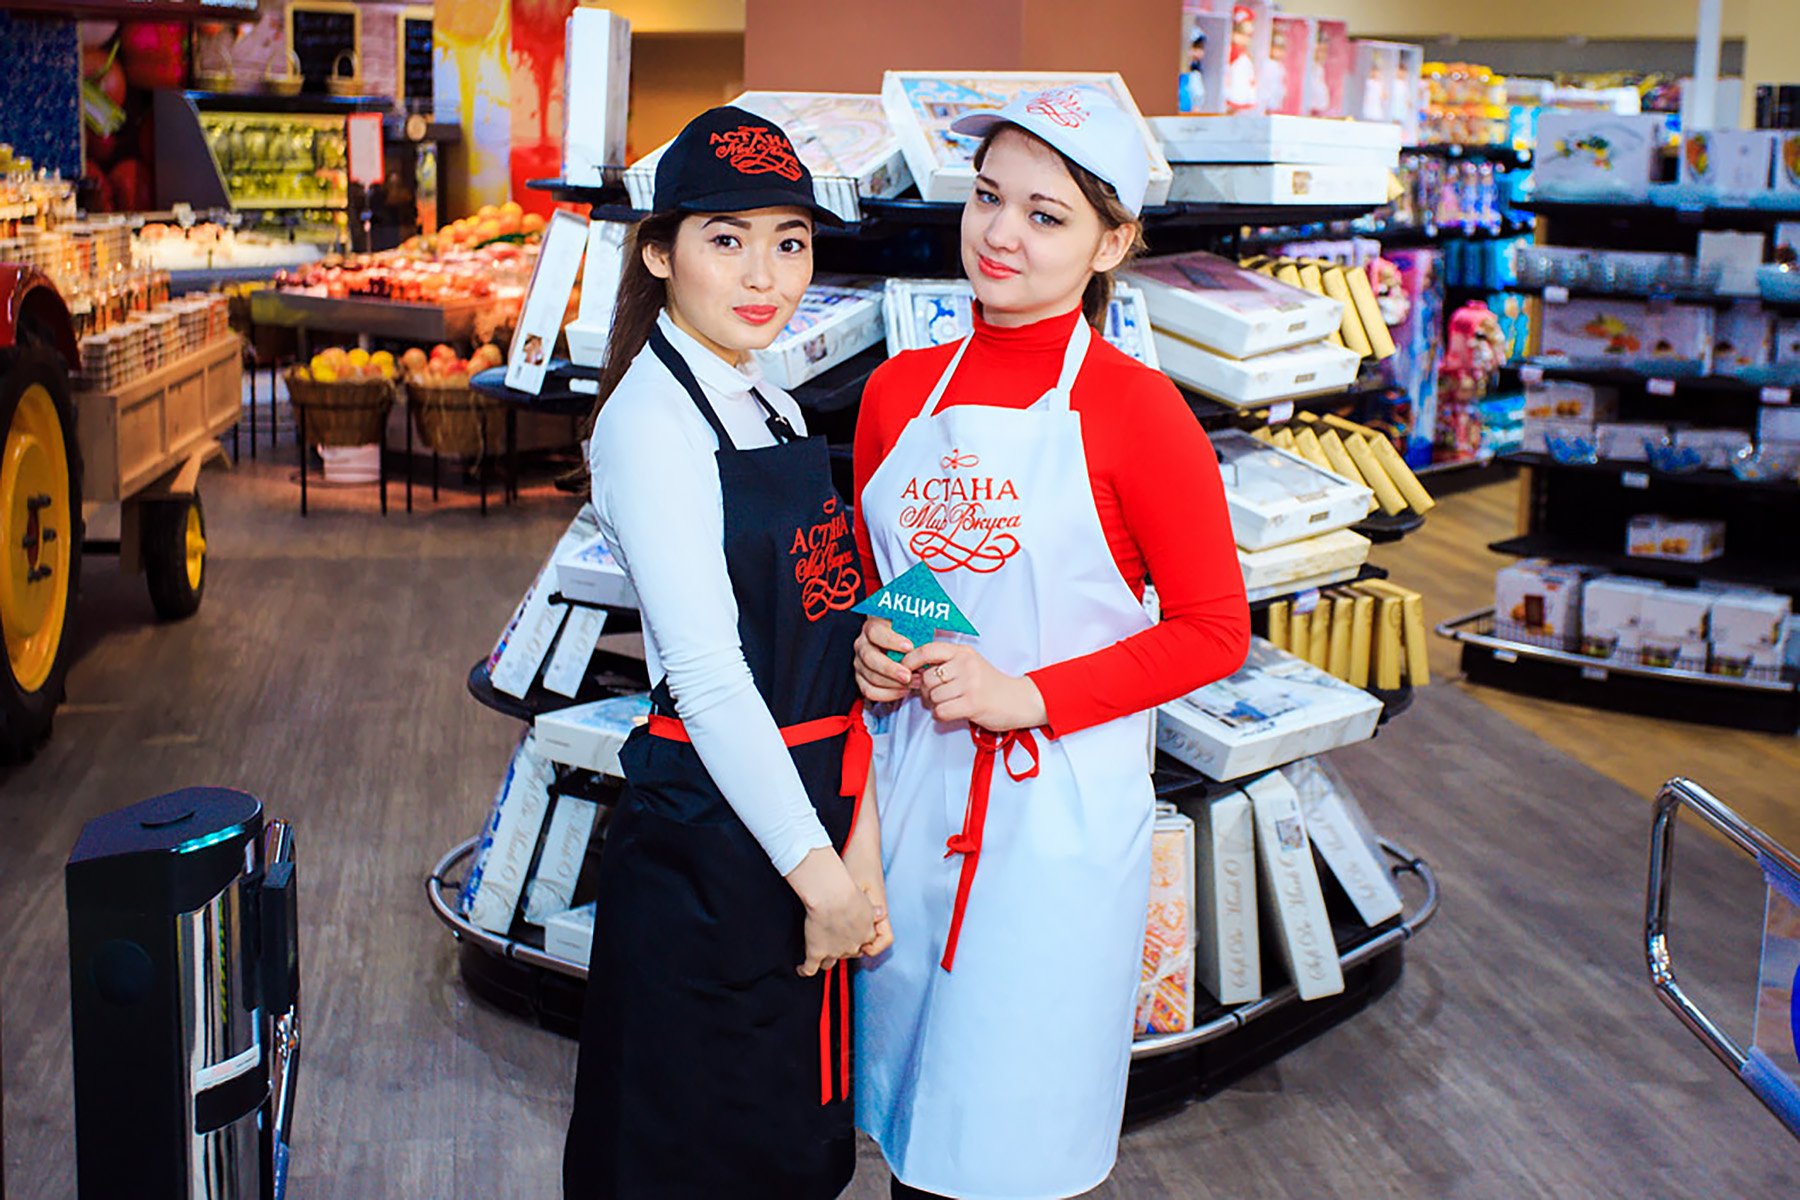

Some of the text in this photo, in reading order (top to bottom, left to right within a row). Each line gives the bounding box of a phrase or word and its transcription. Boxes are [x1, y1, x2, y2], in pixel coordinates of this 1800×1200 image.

[900, 477, 1020, 502] АСТАНА
[789, 511, 849, 555] АСТНА
[877, 591, 950, 621] АКЦИЯ
